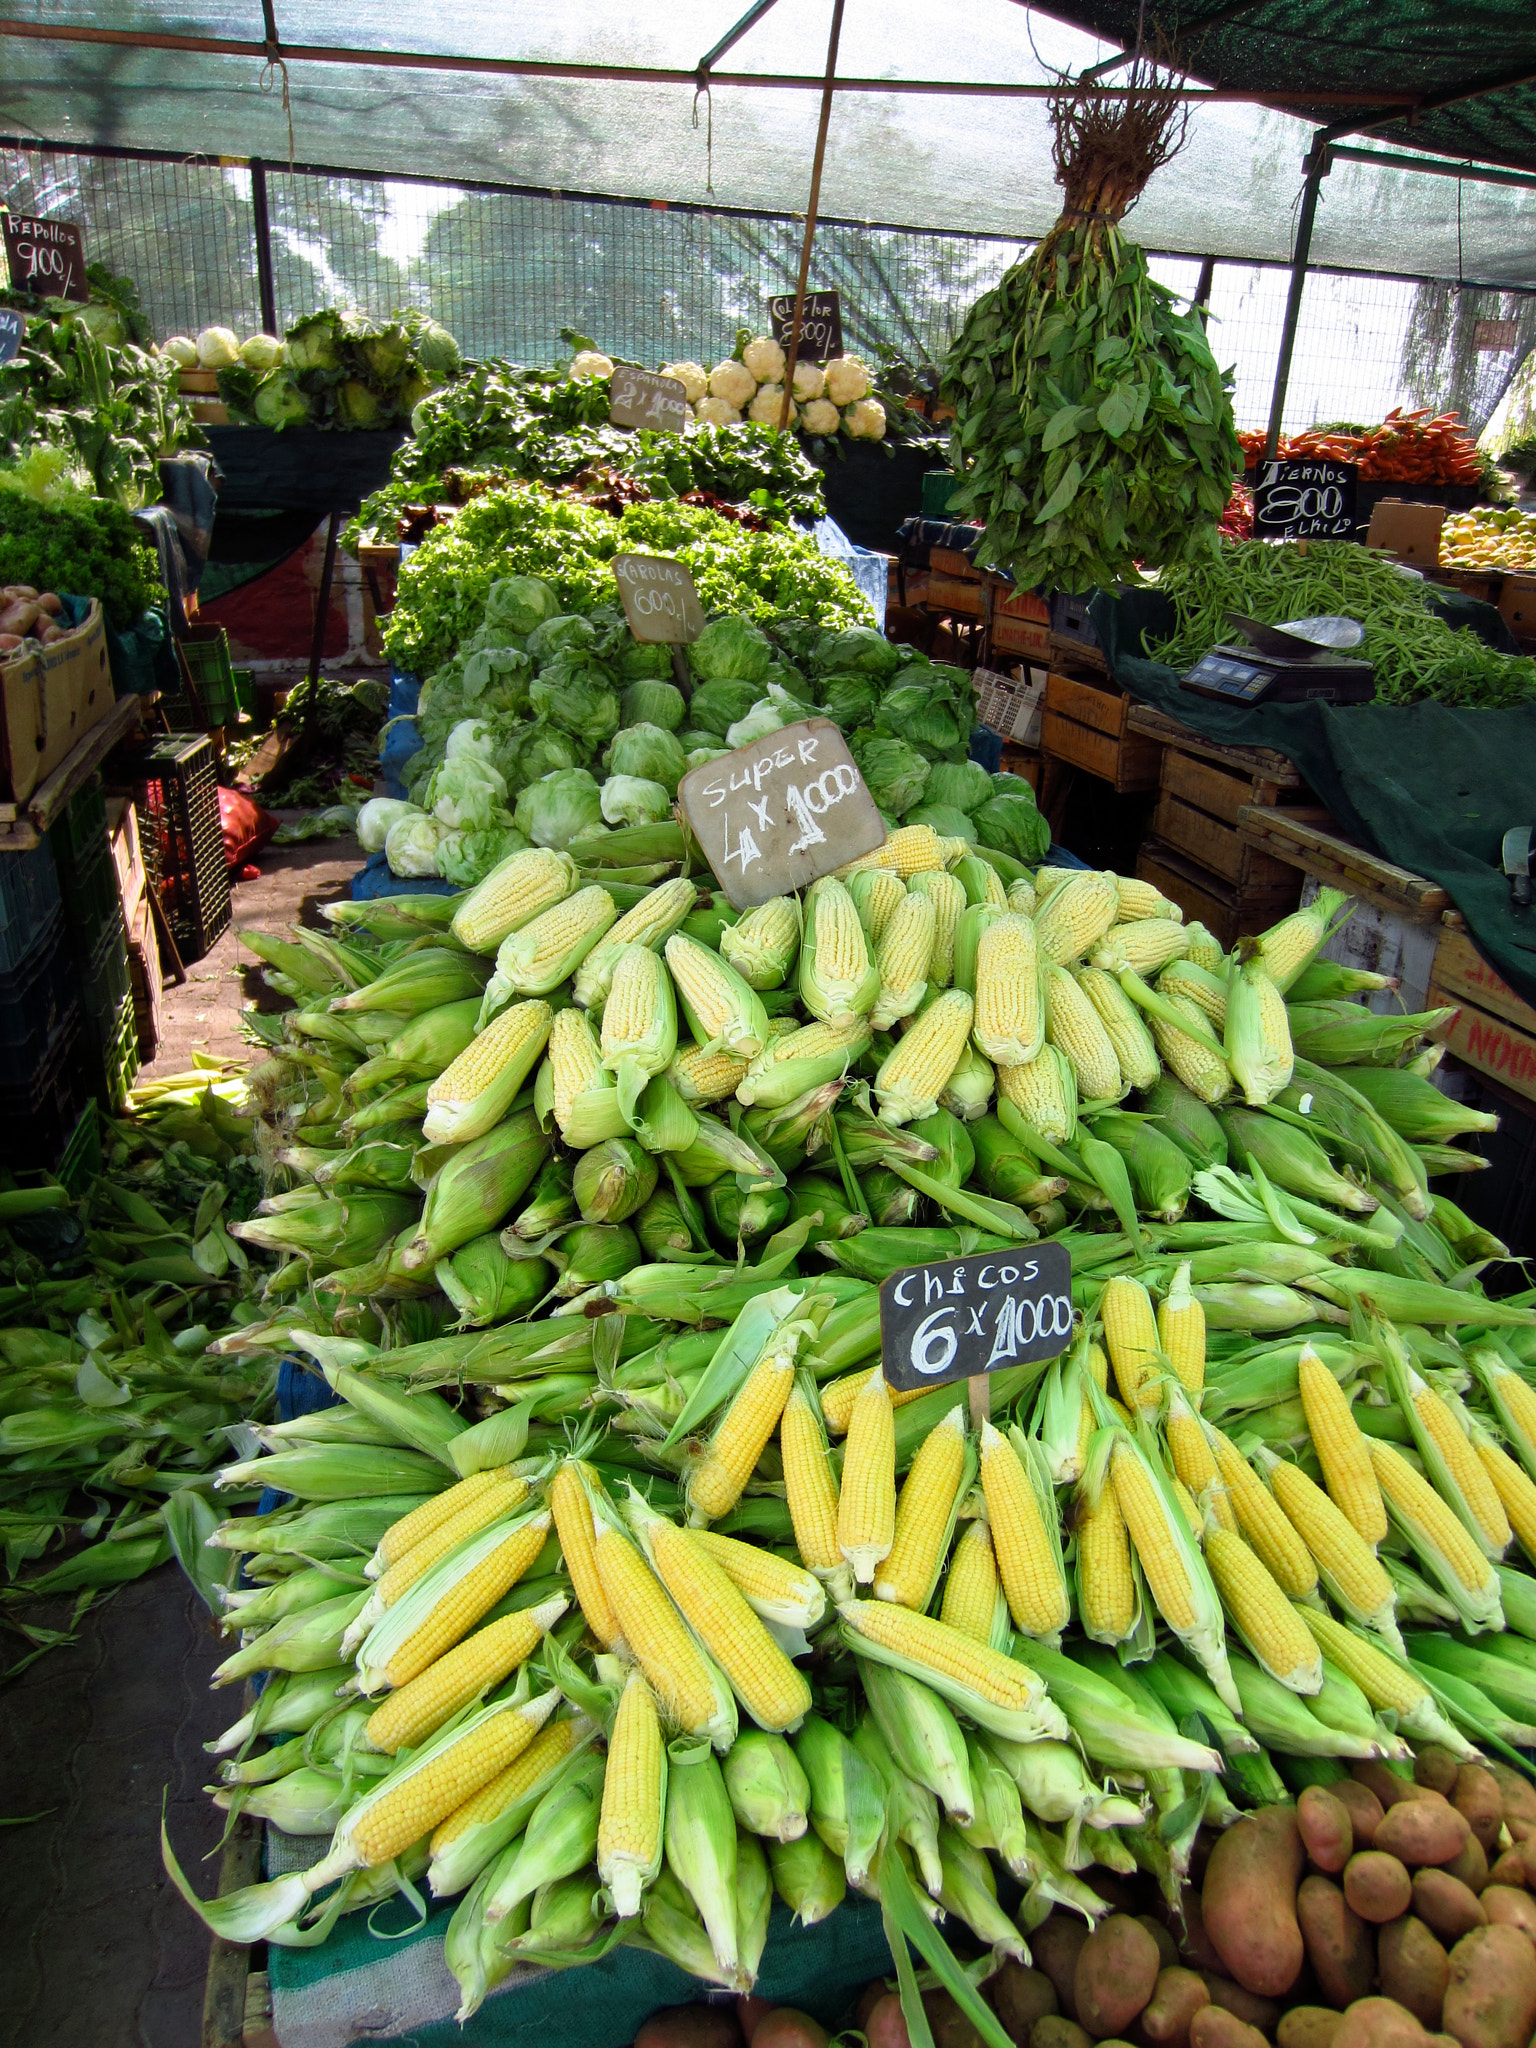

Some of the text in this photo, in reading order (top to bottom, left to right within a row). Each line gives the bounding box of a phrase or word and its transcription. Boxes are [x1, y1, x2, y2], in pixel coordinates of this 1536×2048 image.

[17, 242, 64, 279] 900
[613, 381, 637, 409] 2
[645, 391, 685, 424] 1000
[1258, 486, 1343, 524] 800
[633, 588, 676, 616] 600
[723, 812, 762, 875] 4
[786, 764, 860, 856] 1000
[910, 1306, 958, 1376] 6
[984, 1293, 1074, 1371] 1000
